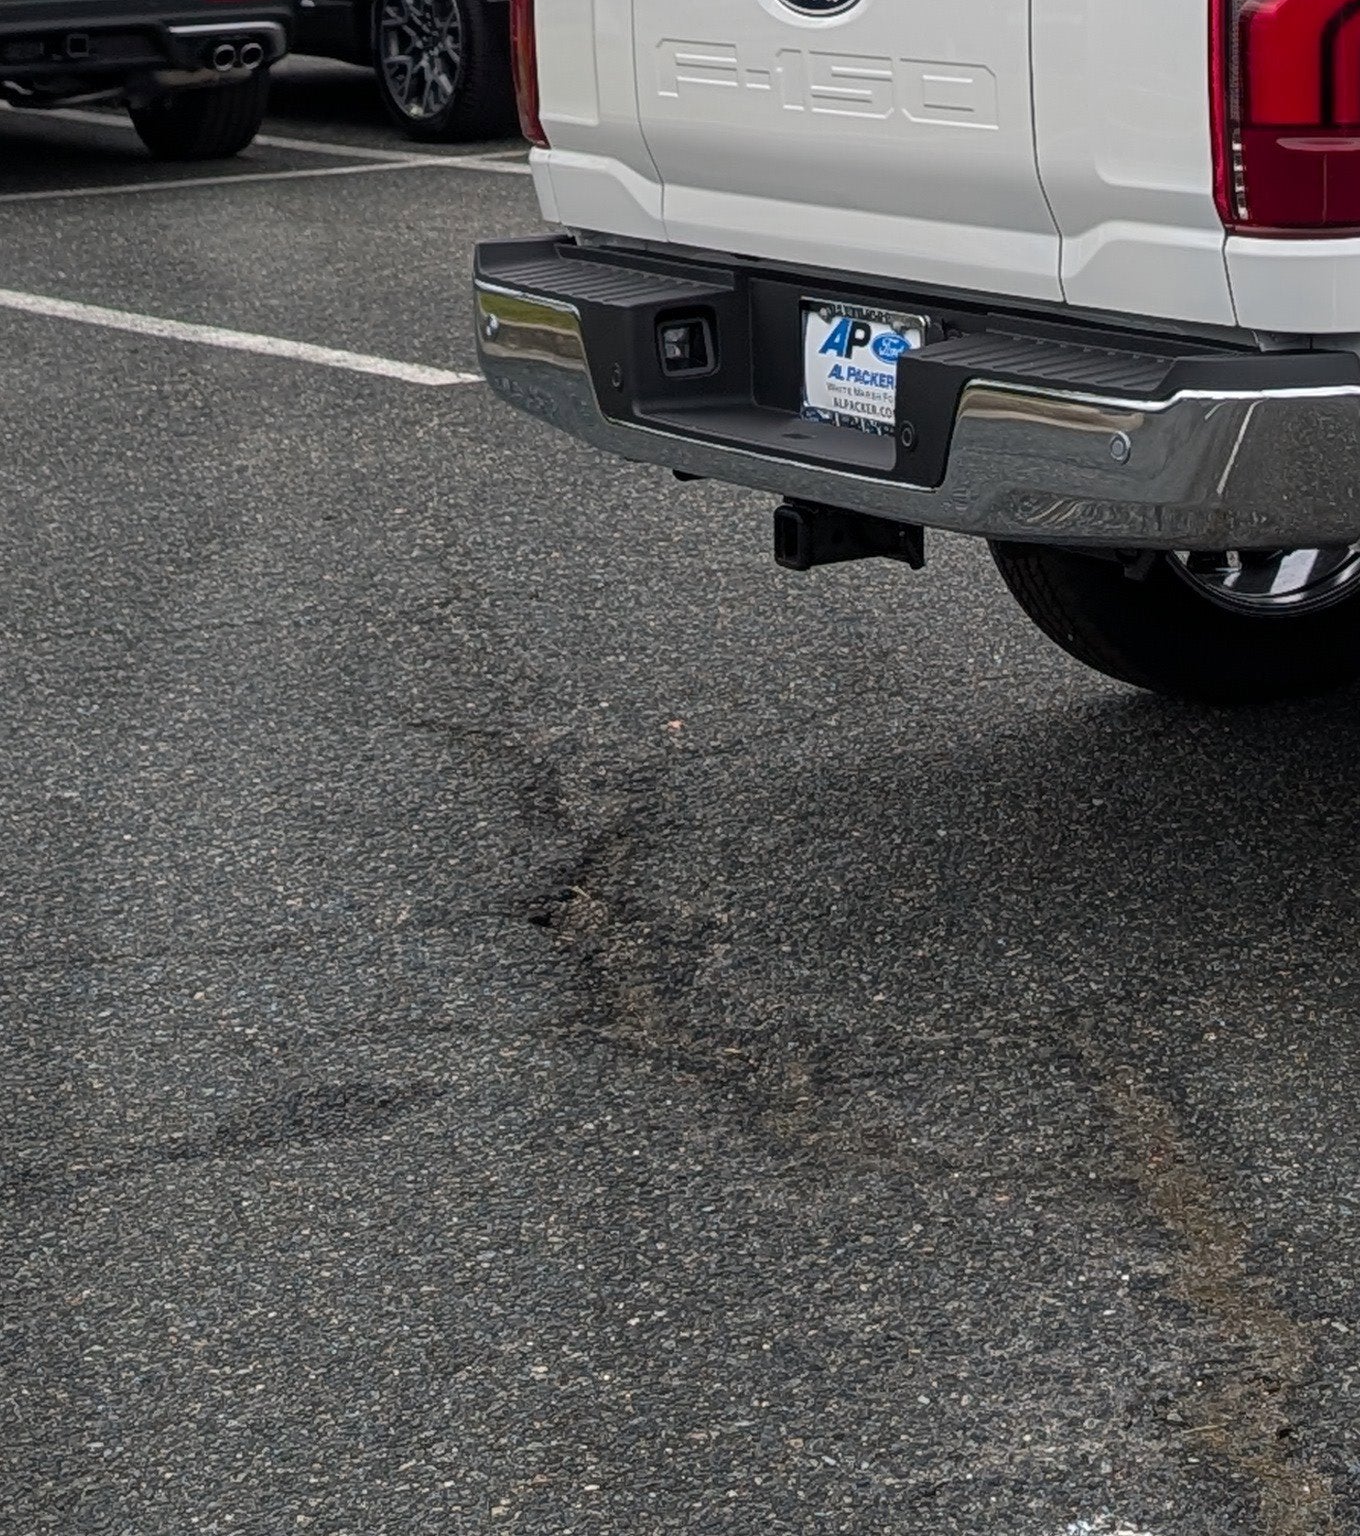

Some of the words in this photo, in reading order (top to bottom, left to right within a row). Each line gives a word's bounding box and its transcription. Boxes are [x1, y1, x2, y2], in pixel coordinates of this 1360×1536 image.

[655, 37, 999, 131] F-150
[818, 317, 871, 359] AP
[828, 363, 845, 381] AL
[846, 366, 895, 389] PACKER
[833, 397, 895, 419] ALPACKER.CO
